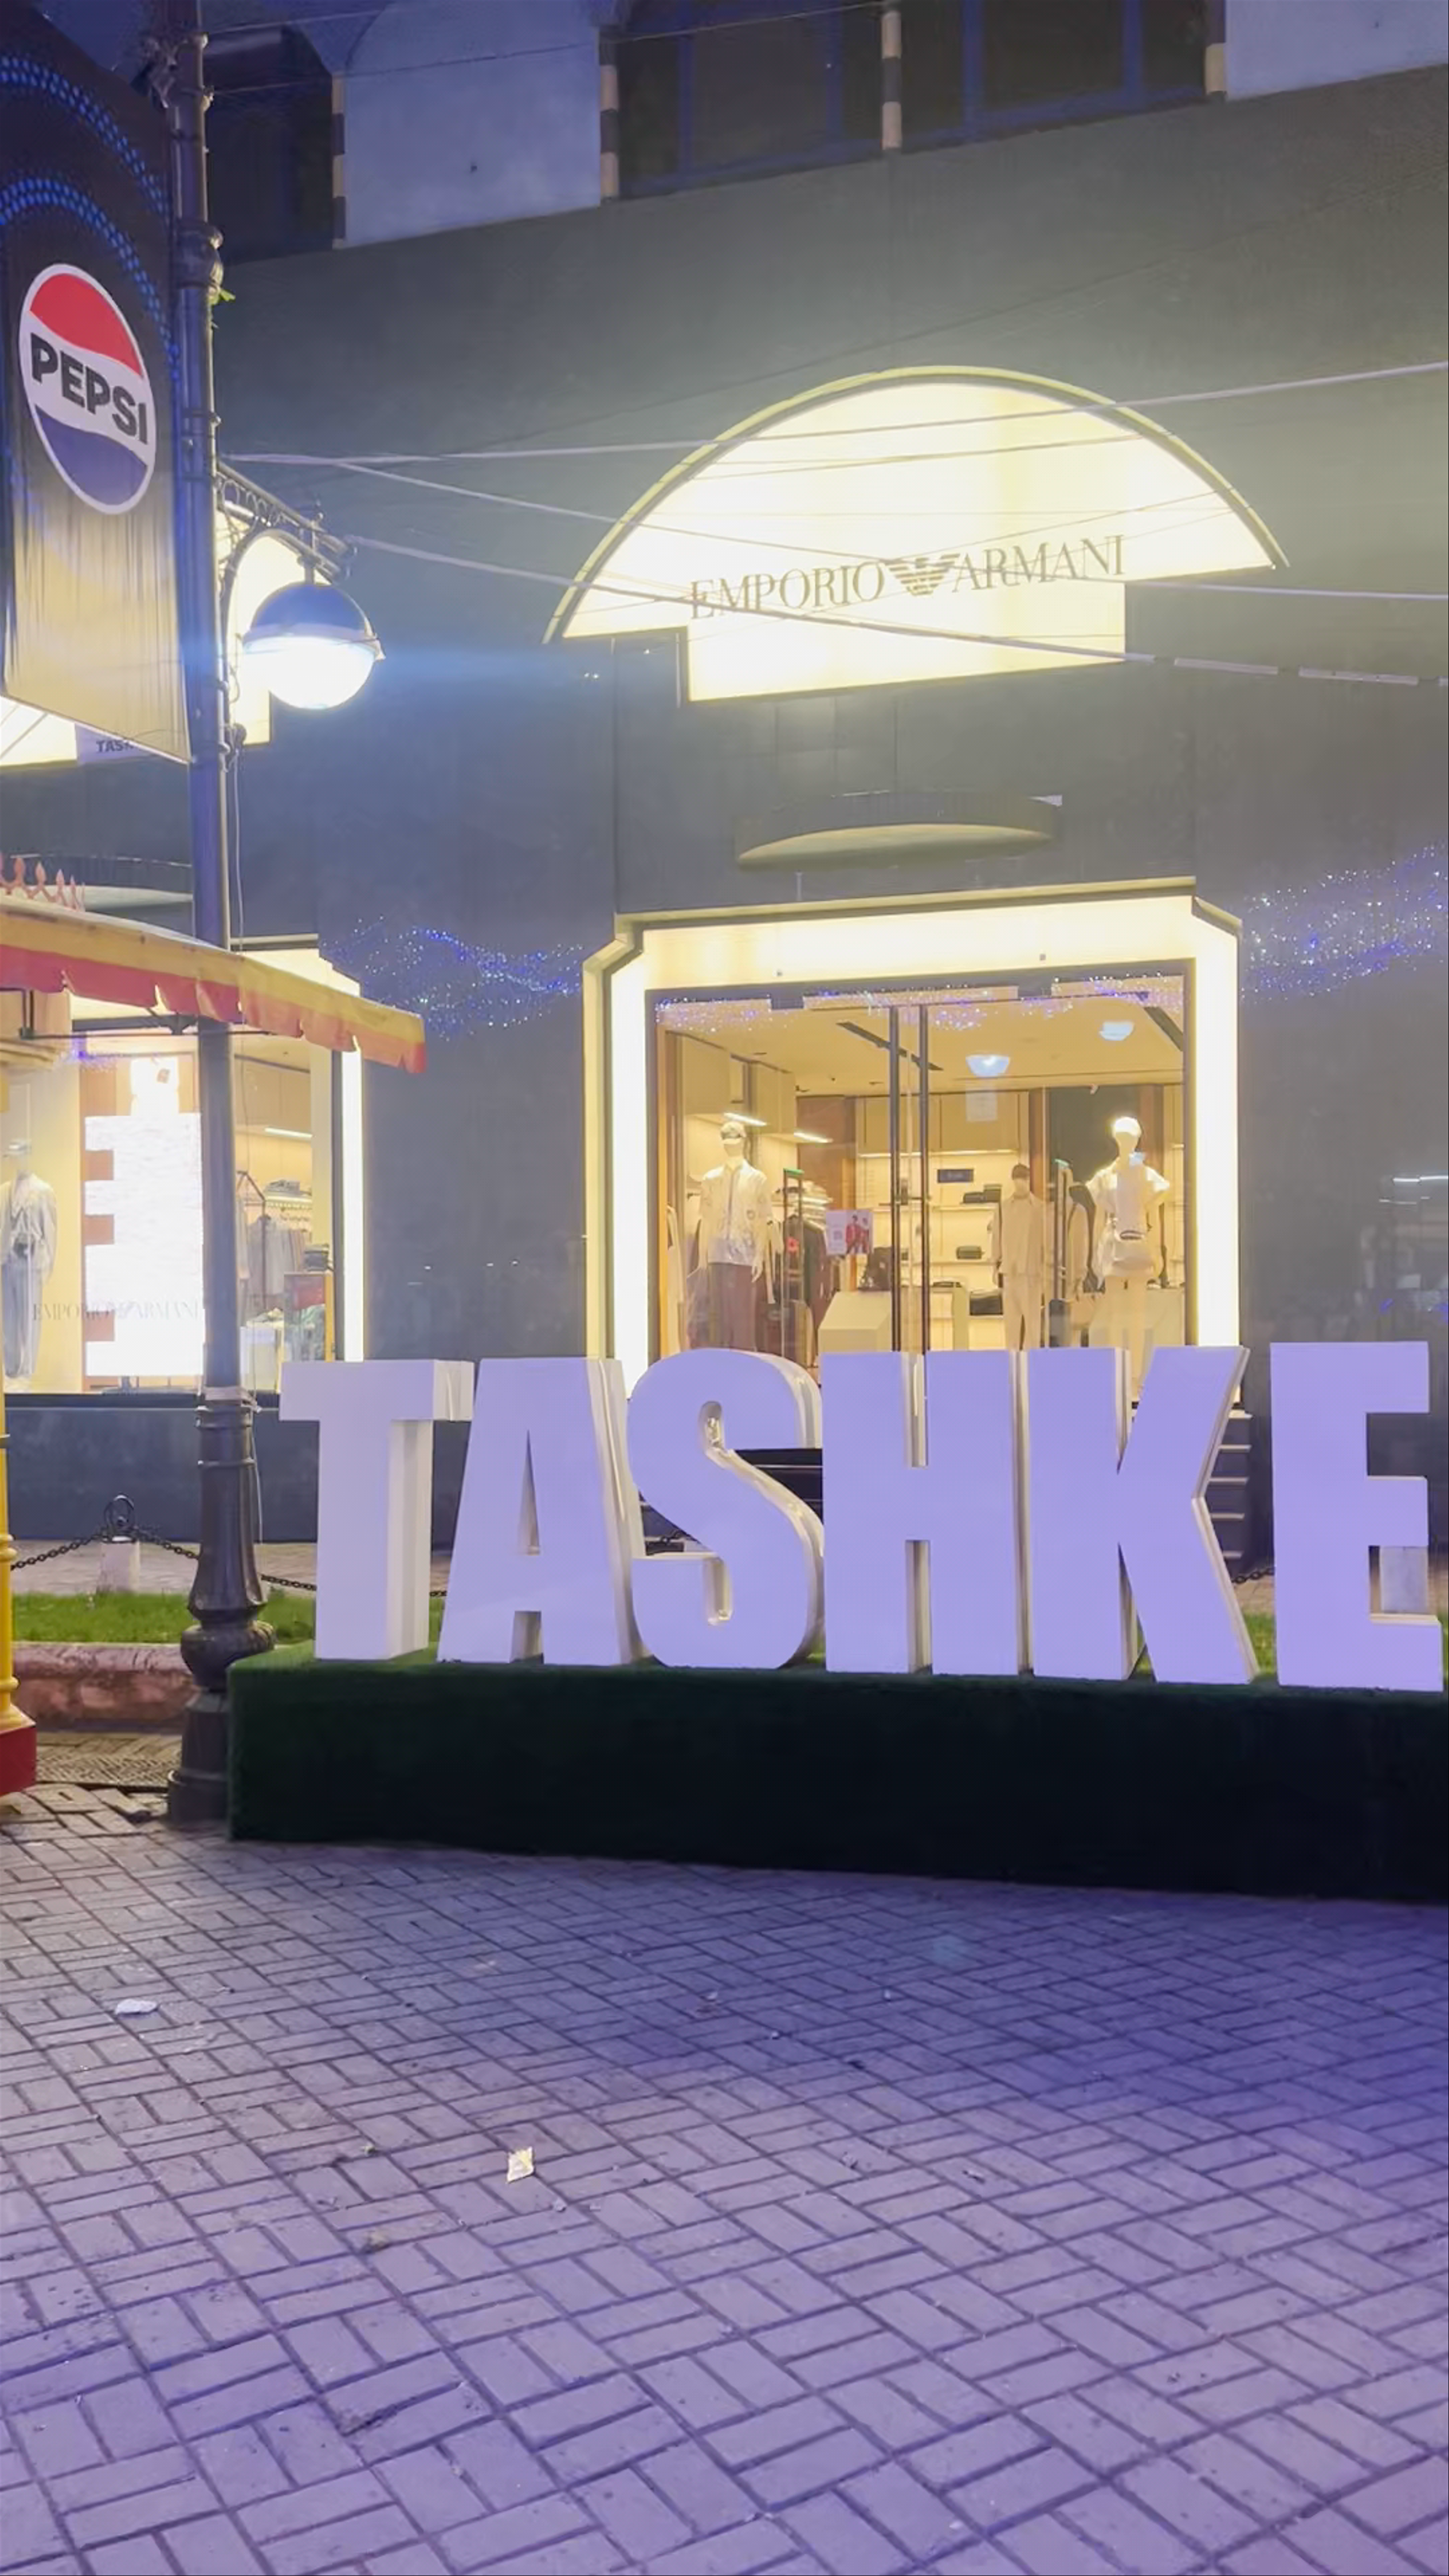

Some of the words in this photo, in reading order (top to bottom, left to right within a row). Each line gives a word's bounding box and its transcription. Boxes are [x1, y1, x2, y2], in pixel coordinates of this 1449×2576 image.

[30, 332, 148, 445] PEPSI
[690, 561, 885, 620] EMPORIO
[951, 534, 1124, 593] ARMANI
[278, 1341, 1444, 1692] TASHKE
